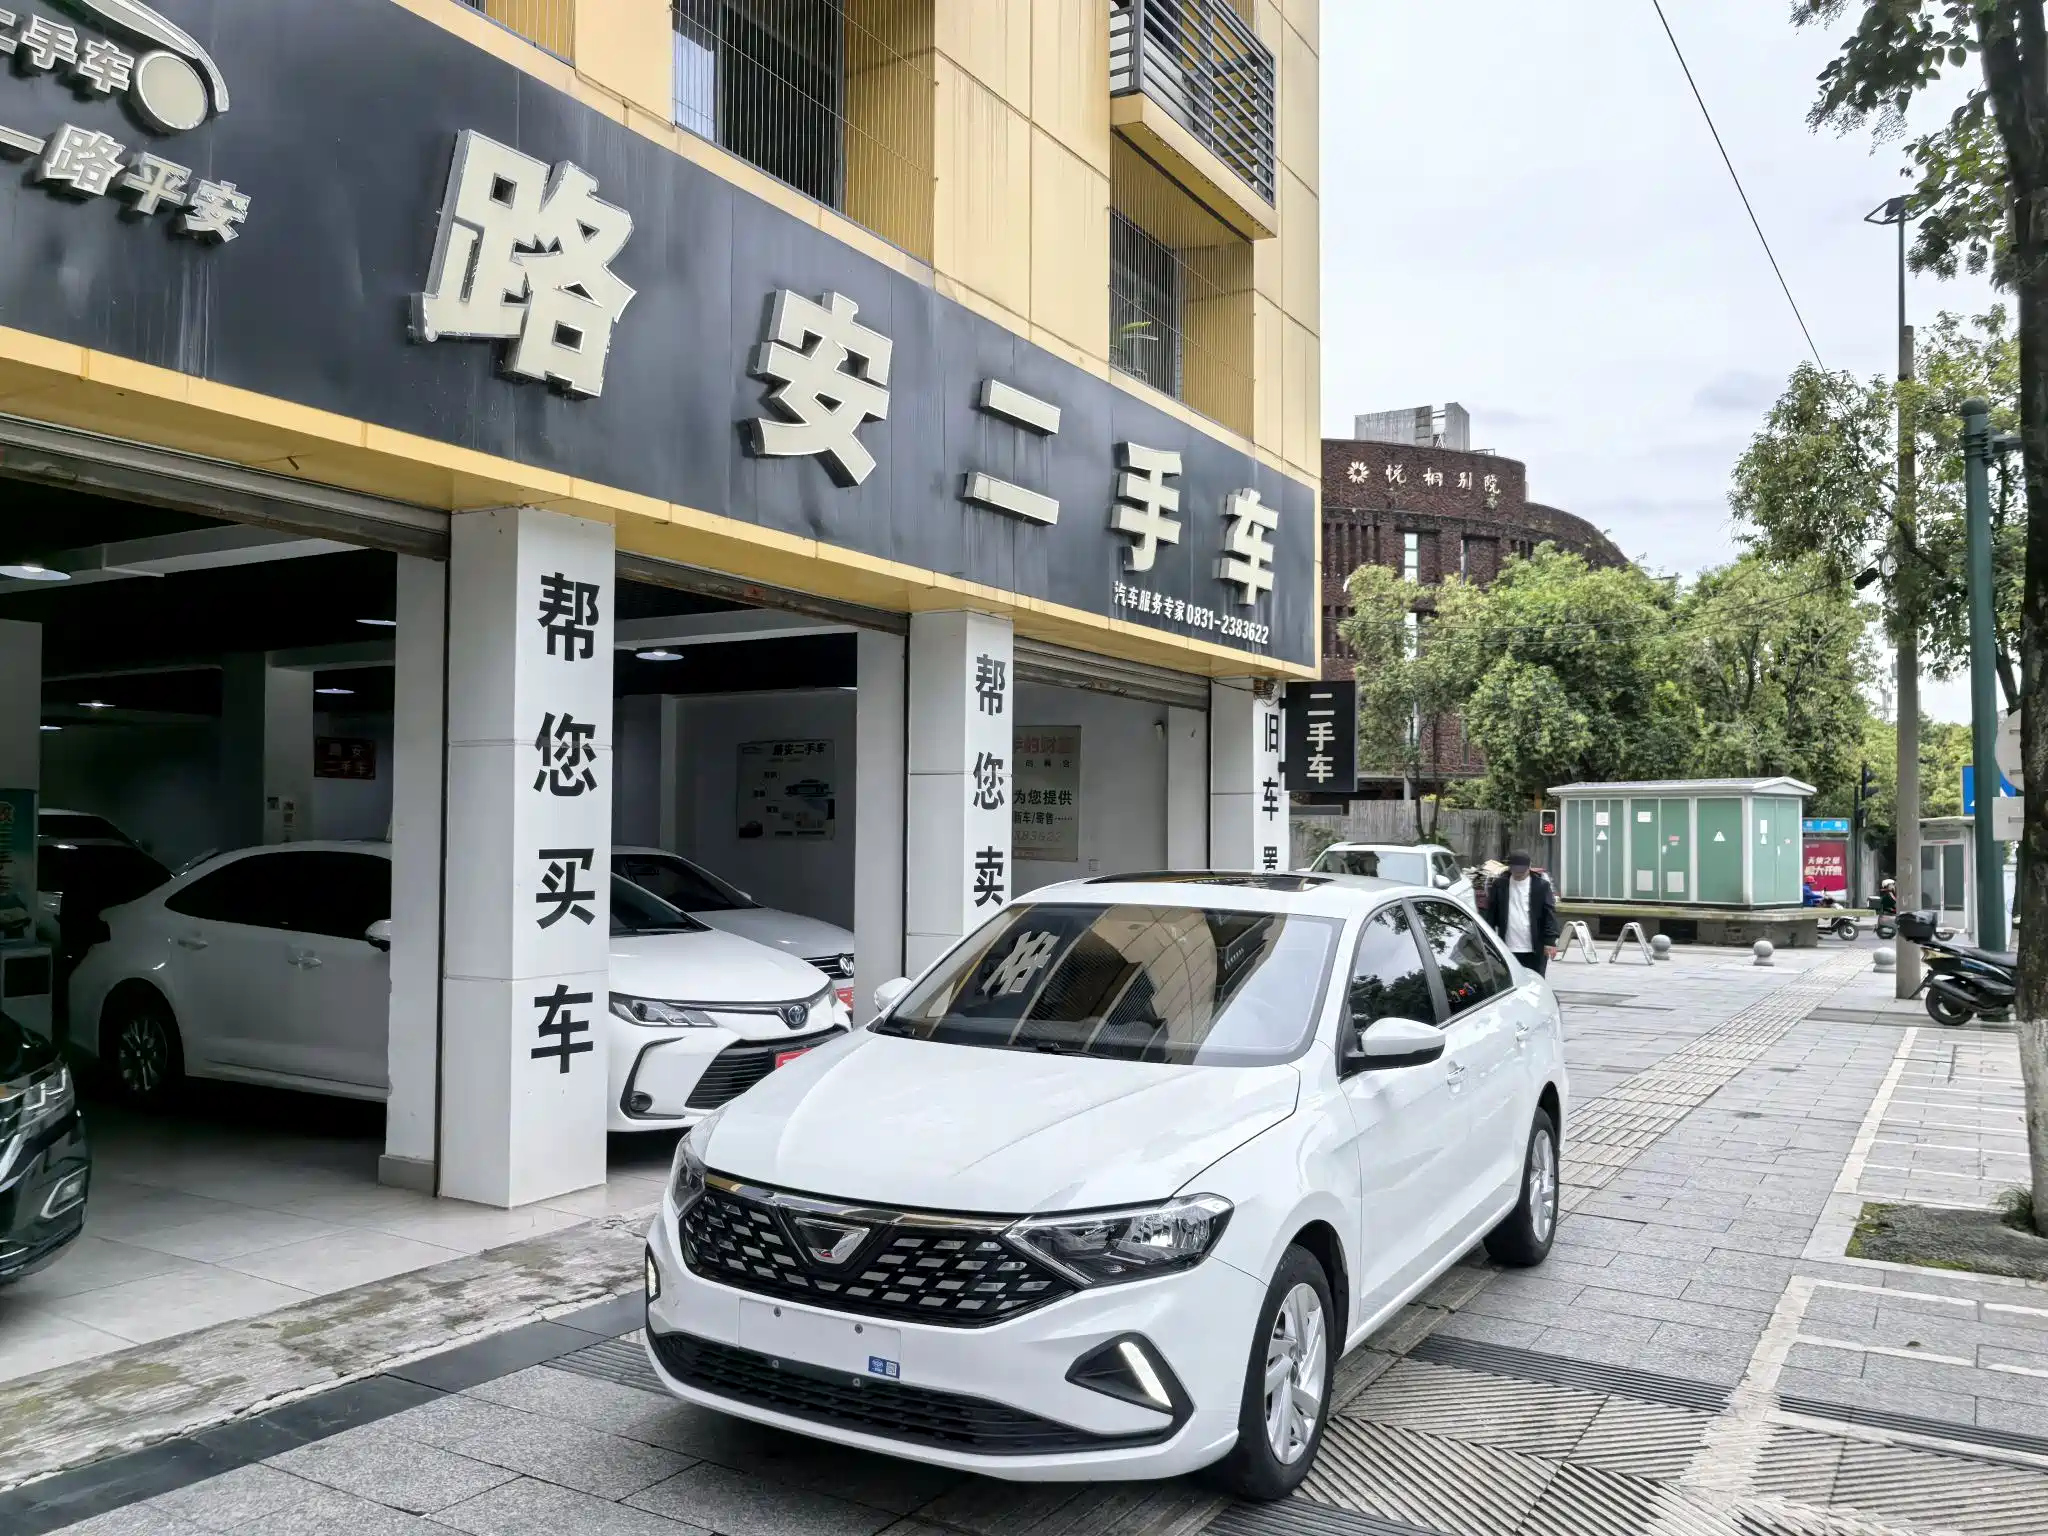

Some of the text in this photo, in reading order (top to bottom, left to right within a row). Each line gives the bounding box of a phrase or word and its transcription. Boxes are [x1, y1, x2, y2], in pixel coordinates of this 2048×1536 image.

[0, 123, 251, 242] 一路平安
[411, 129, 1279, 605] 路安二手车
[1114, 580, 1269, 645] 汽车服务专家 0831-2383622
[1306, 693, 1336, 784] 二手车
[531, 572, 600, 1074] 帮您买车
[1013, 788, 1072, 805] 为您提供
